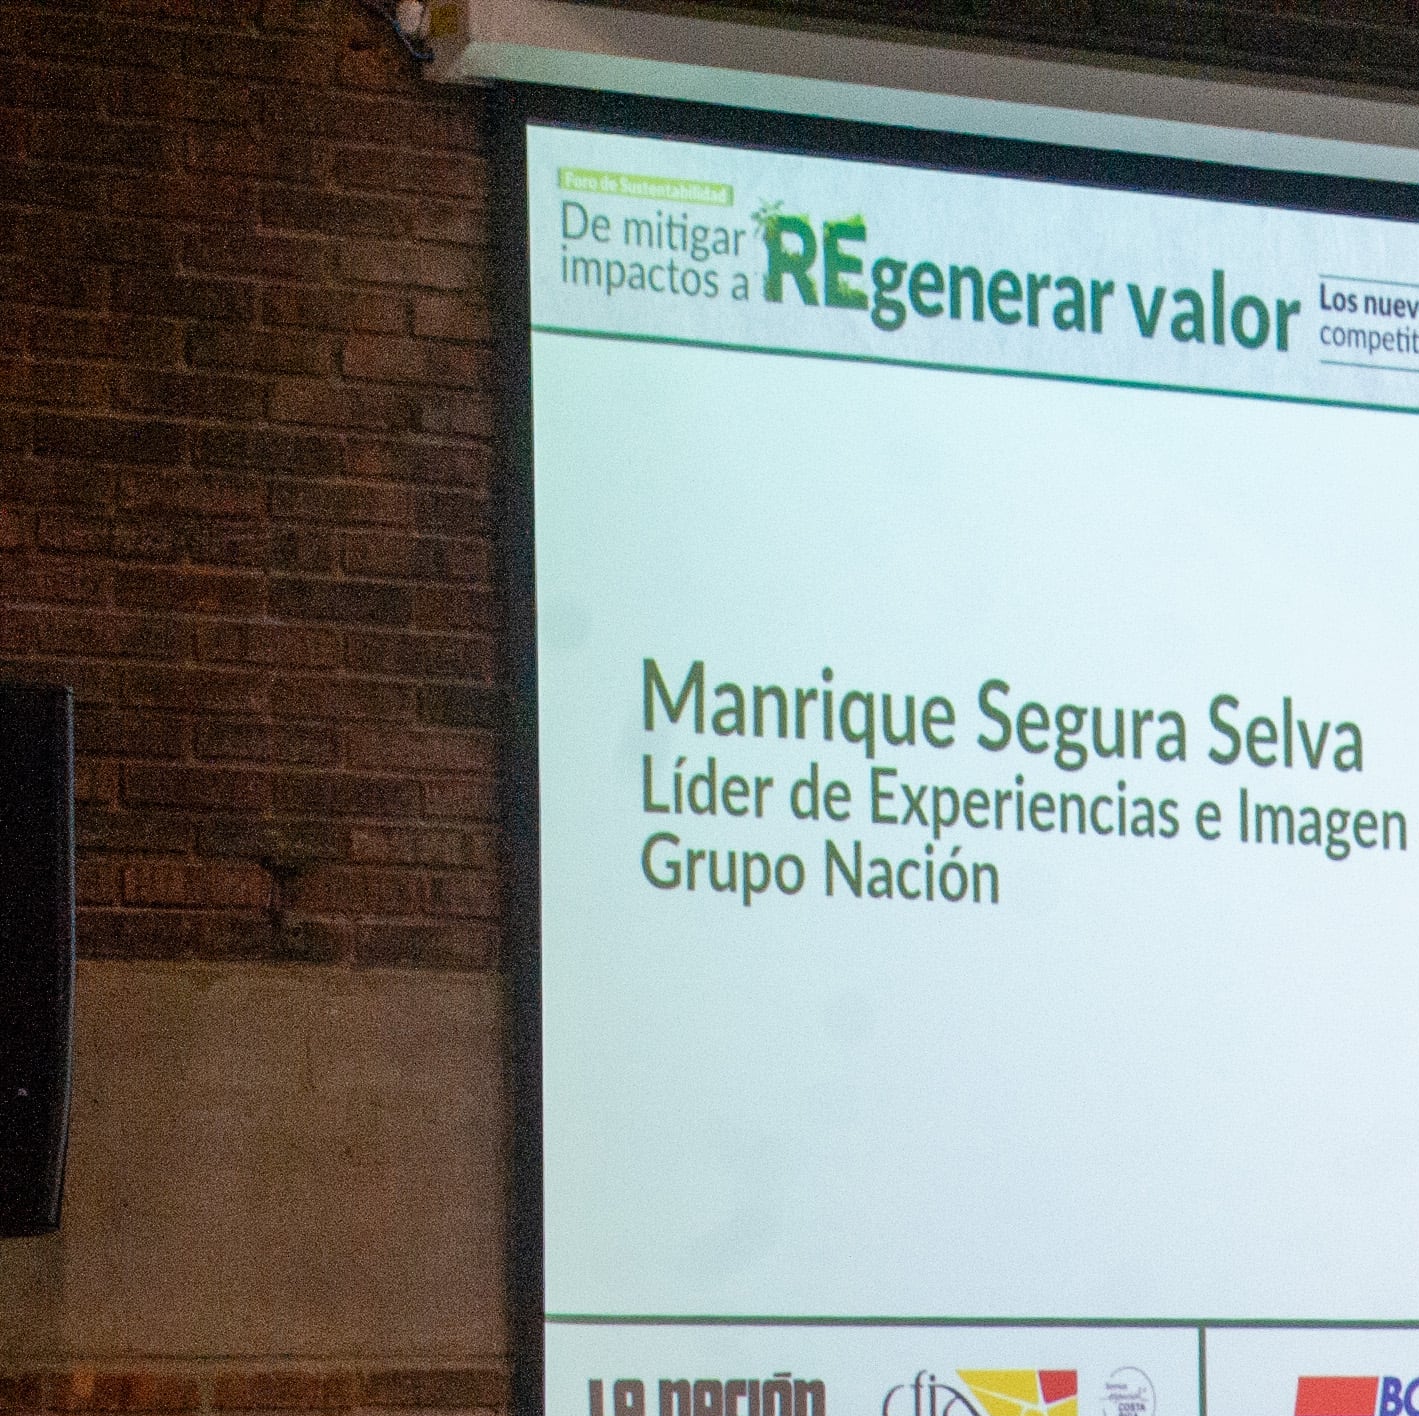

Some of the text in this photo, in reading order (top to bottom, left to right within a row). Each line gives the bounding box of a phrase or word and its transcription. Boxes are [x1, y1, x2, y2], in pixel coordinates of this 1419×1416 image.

[565, 171, 598, 190] Foro
[561, 200, 747, 260] De mitigar
[561, 245, 750, 301] impactos a
[1318, 283, 1359, 314] Los
[1126, 267, 1301, 353] valor
[642, 657, 1364, 773] Manrique Segura Selva
[642, 753, 774, 819] Líder
[789, 761, 852, 822] de
[870, 766, 1181, 840] Experiencias
[1196, 799, 1222, 841] e
[1239, 786, 1408, 862] Imagen
[641, 831, 999, 907] Grupo Nación
